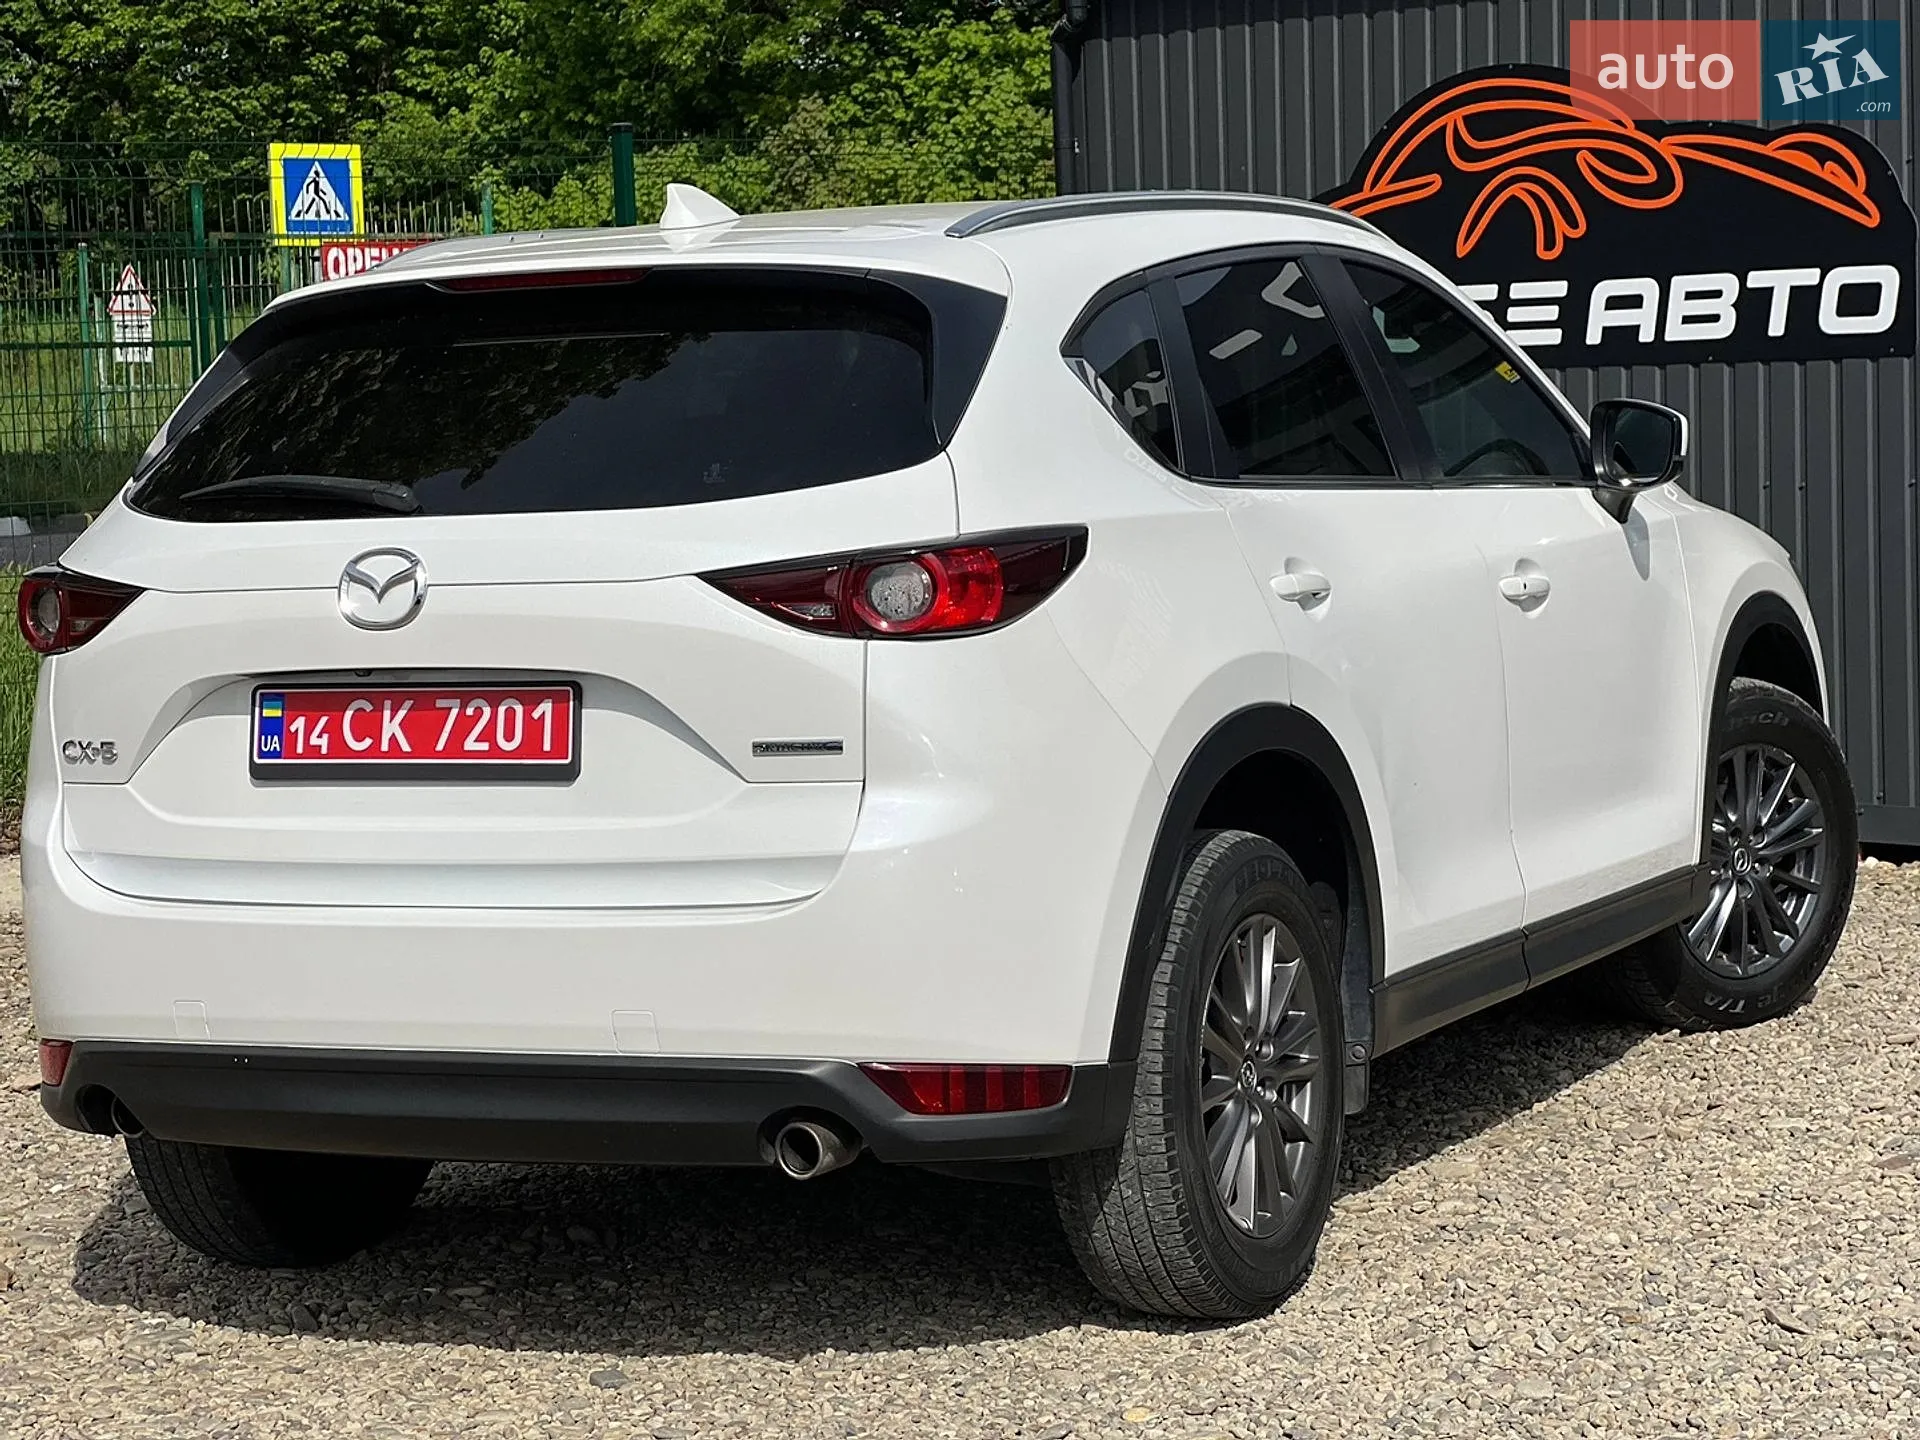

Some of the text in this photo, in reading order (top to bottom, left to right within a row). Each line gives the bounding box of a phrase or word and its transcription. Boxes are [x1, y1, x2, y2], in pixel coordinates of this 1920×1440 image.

[1586, 265, 1900, 346] АВТО
[261, 735, 280, 752] UA
[289, 698, 553, 754] 14 CK 7201
[62, 740, 118, 765] CX-5
